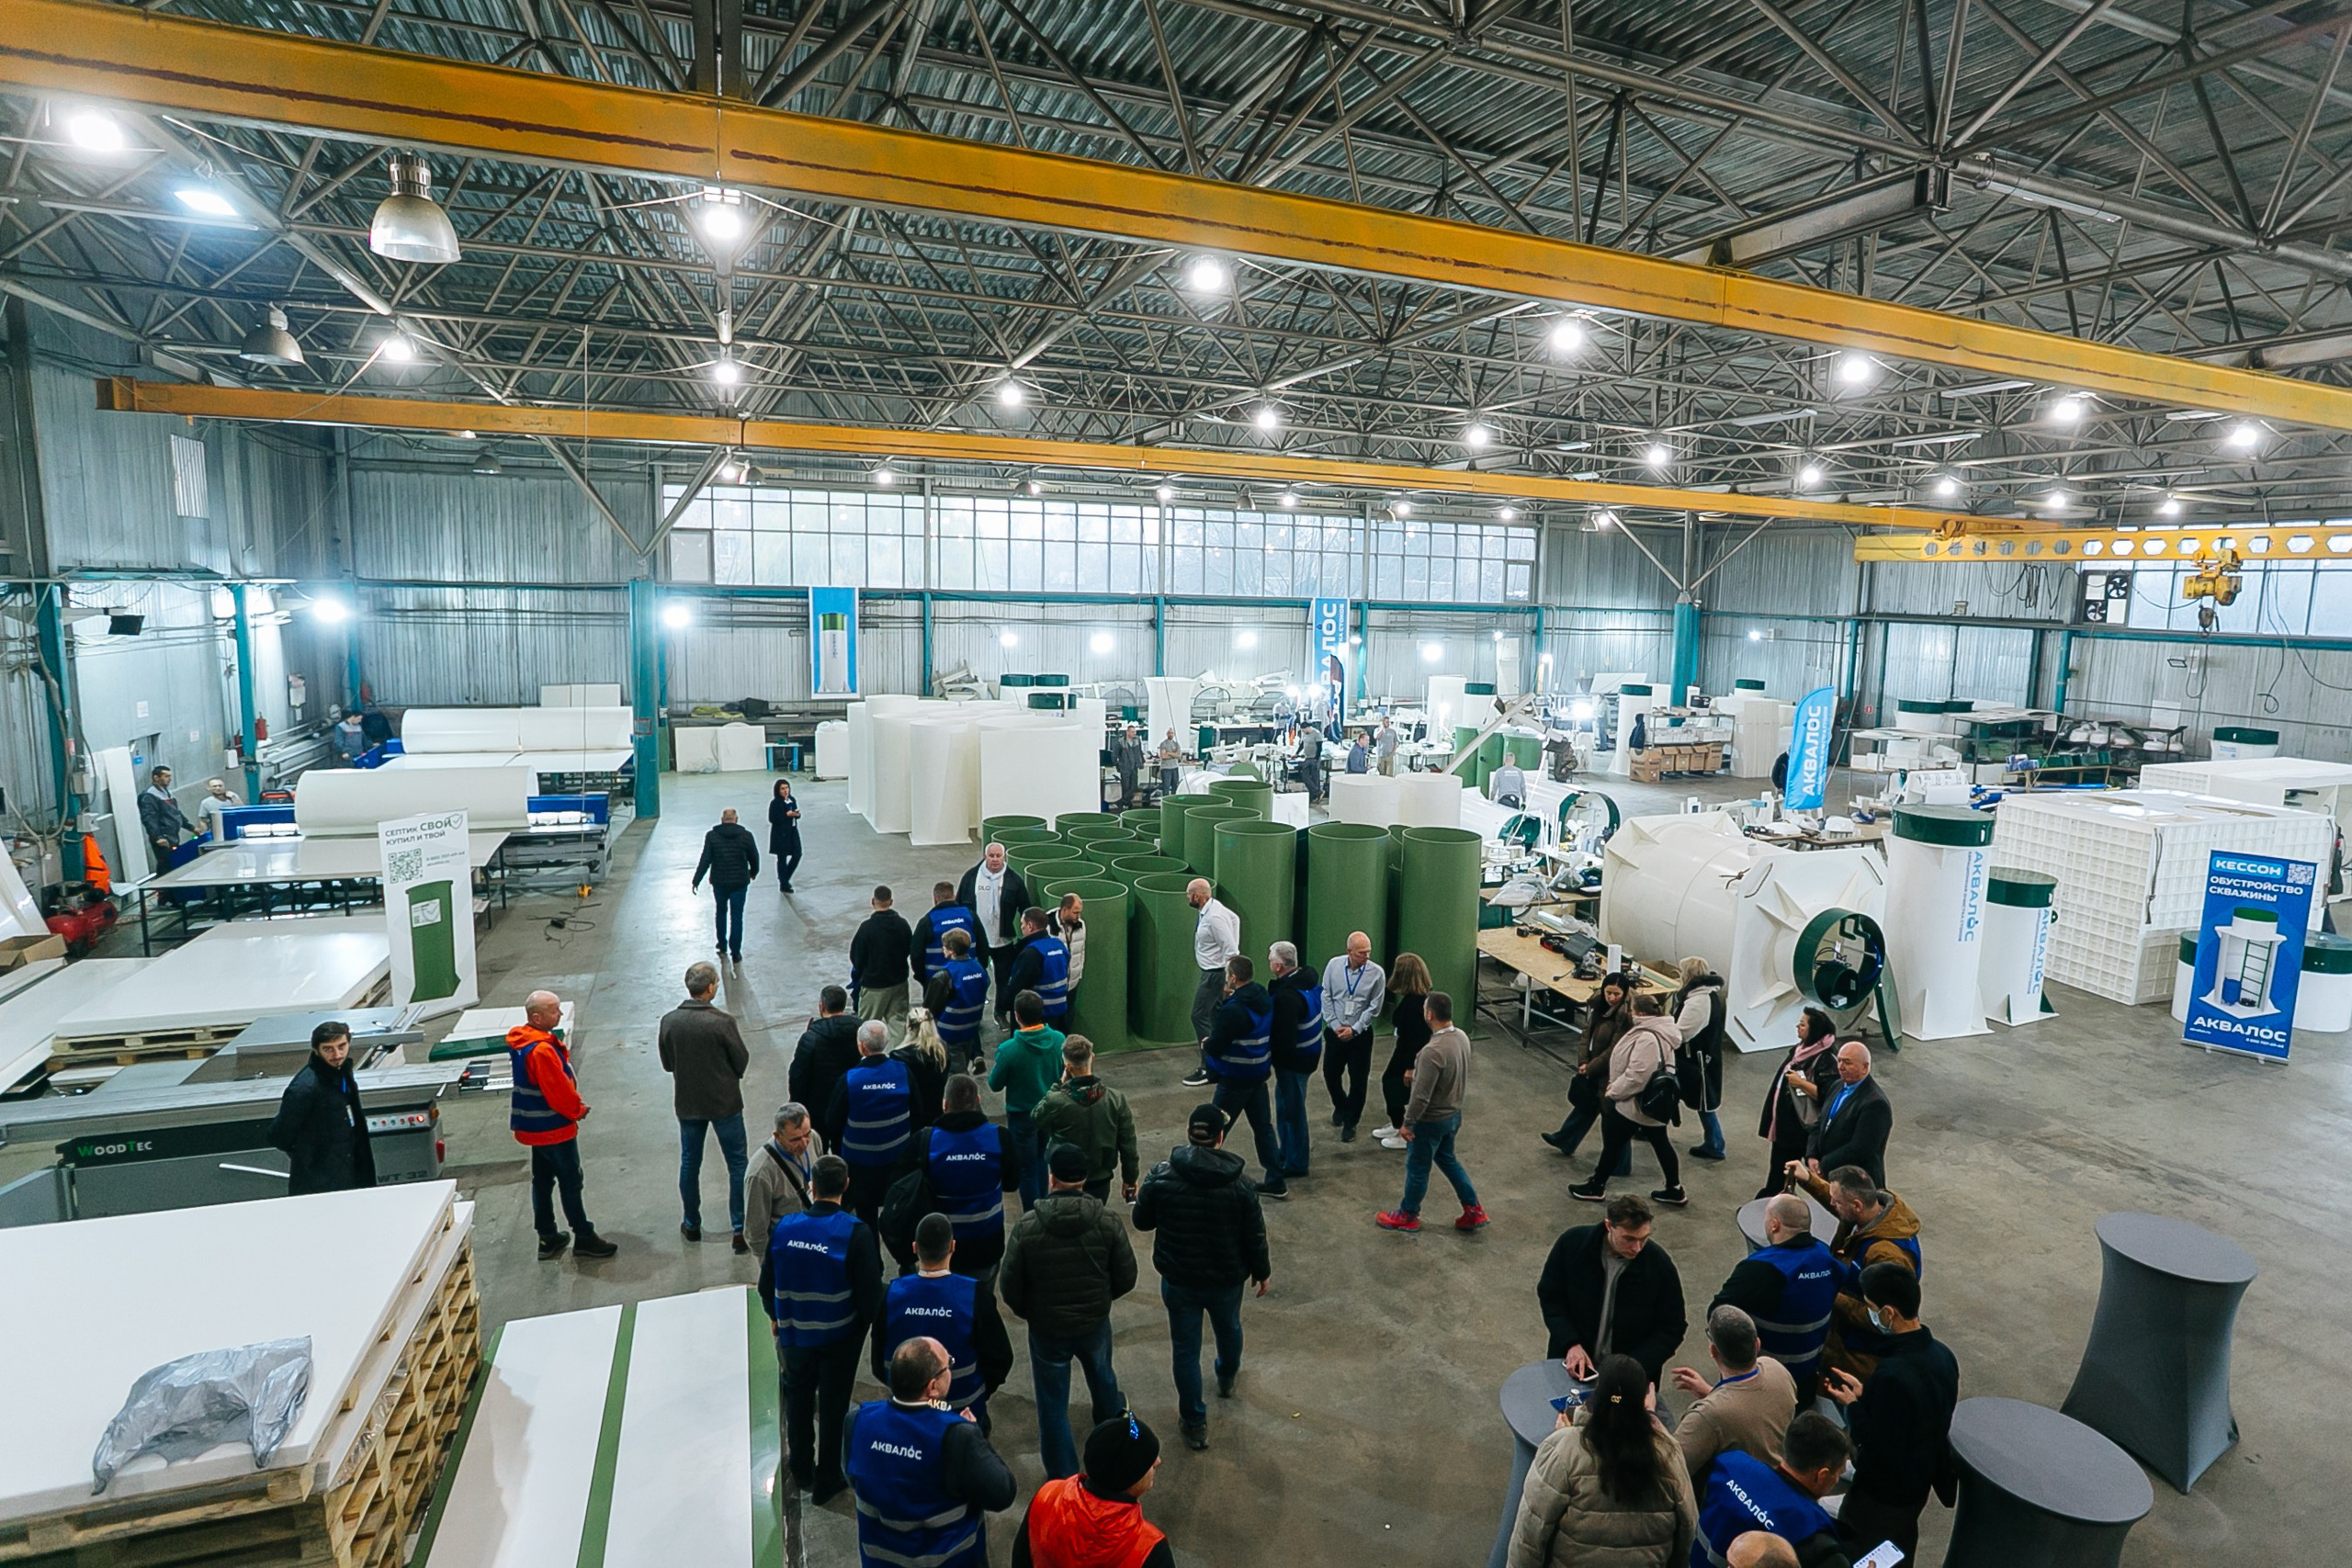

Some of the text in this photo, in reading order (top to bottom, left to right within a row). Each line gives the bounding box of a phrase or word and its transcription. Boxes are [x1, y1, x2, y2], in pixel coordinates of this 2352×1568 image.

[1802, 705, 1822, 796] АКВАЛОС
[385, 817, 452, 837] СЕПТИК СВОЙ
[386, 836, 415, 846] КУПИЛ
[424, 829, 446, 840] ТВОЙ
[2215, 859, 2281, 876] КЕССОН
[2210, 874, 2303, 896] ОБУСТРОЙСТВО
[1964, 851, 1984, 942] АКВАЛОС
[2209, 886, 2278, 903] СКВАЖИНЫ
[941, 917, 965, 926] АКВАЛОС
[2032, 908, 2050, 994] АКВАЛОС
[2193, 1016, 2287, 1043] АКВАЛОС
[862, 1082, 896, 1090] АКВАЛОС
[945, 1152, 986, 1162] АКВАЛОС
[786, 1239, 829, 1254] АКВАЛОС
[904, 1306, 953, 1317] АКВАЛОС
[870, 1439, 922, 1461] АКВАЛОС
[1725, 1479, 1775, 1530] АКВАЛОС
